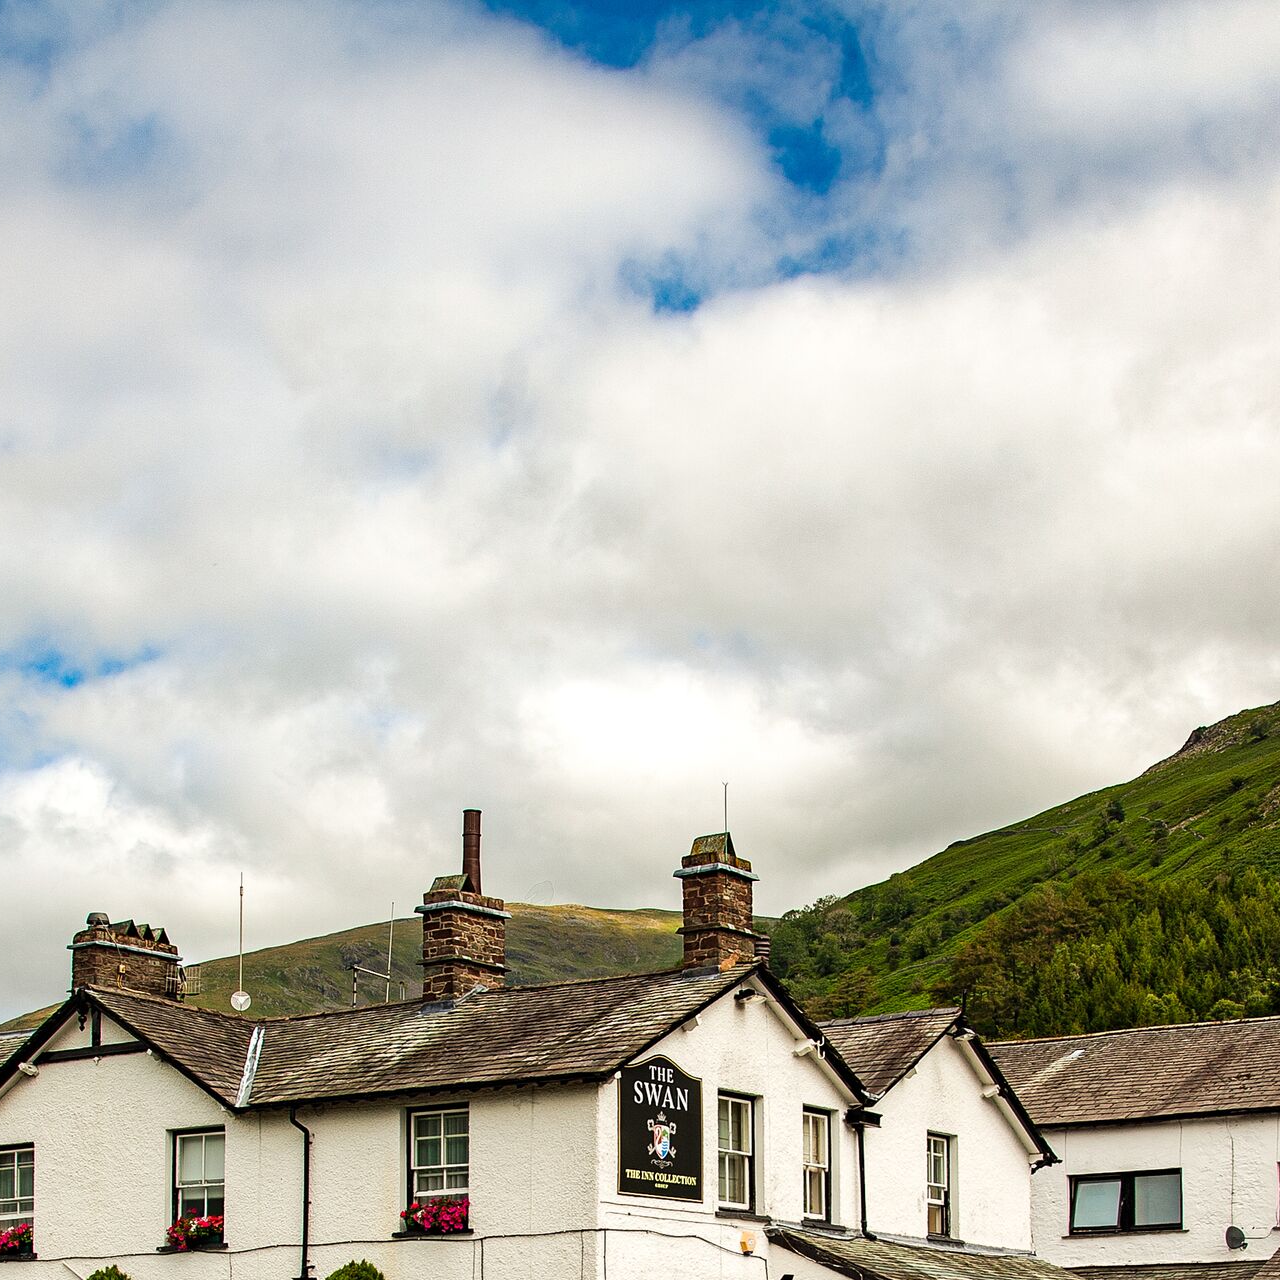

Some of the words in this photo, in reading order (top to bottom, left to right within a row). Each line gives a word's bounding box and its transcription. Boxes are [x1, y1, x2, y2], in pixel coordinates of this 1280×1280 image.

[649, 1065, 674, 1084] THE
[634, 1080, 689, 1111] SWAN
[625, 1168, 641, 1179] THE
[641, 1170, 655, 1181] INN
[655, 1172, 697, 1186] COLLECTION
